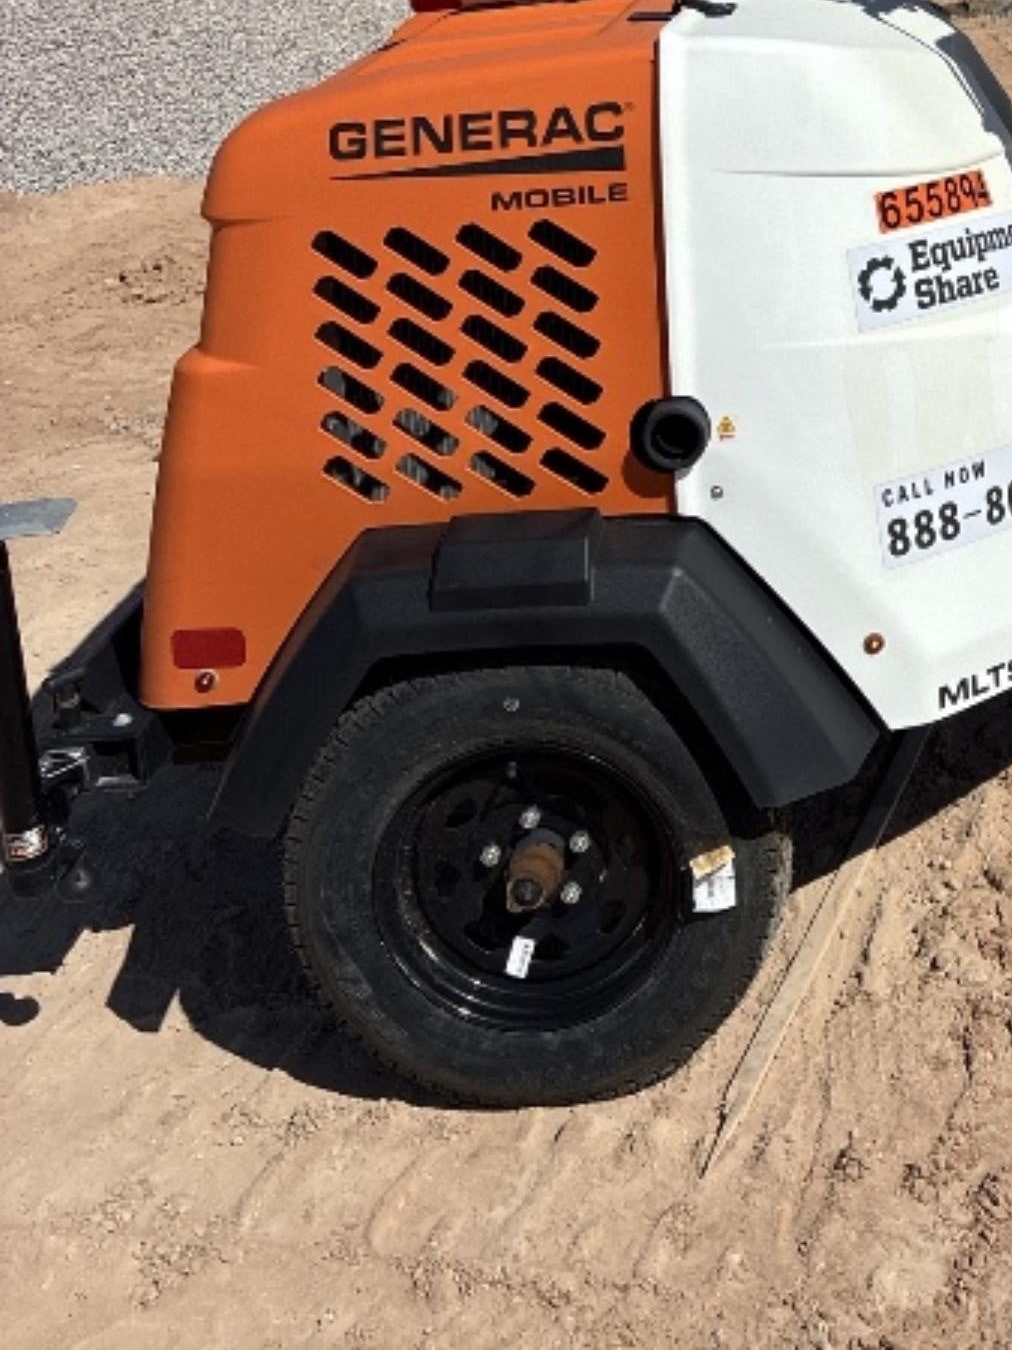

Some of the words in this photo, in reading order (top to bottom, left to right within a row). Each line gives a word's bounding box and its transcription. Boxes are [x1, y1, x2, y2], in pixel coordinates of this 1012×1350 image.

[328, 101, 625, 161] GENERAC
[491, 182, 629, 211] MOBILE
[879, 172, 989, 230] 655894
[914, 267, 1000, 310] Share
[881, 478, 935, 508] CALL
[943, 460, 986, 489] NOW
